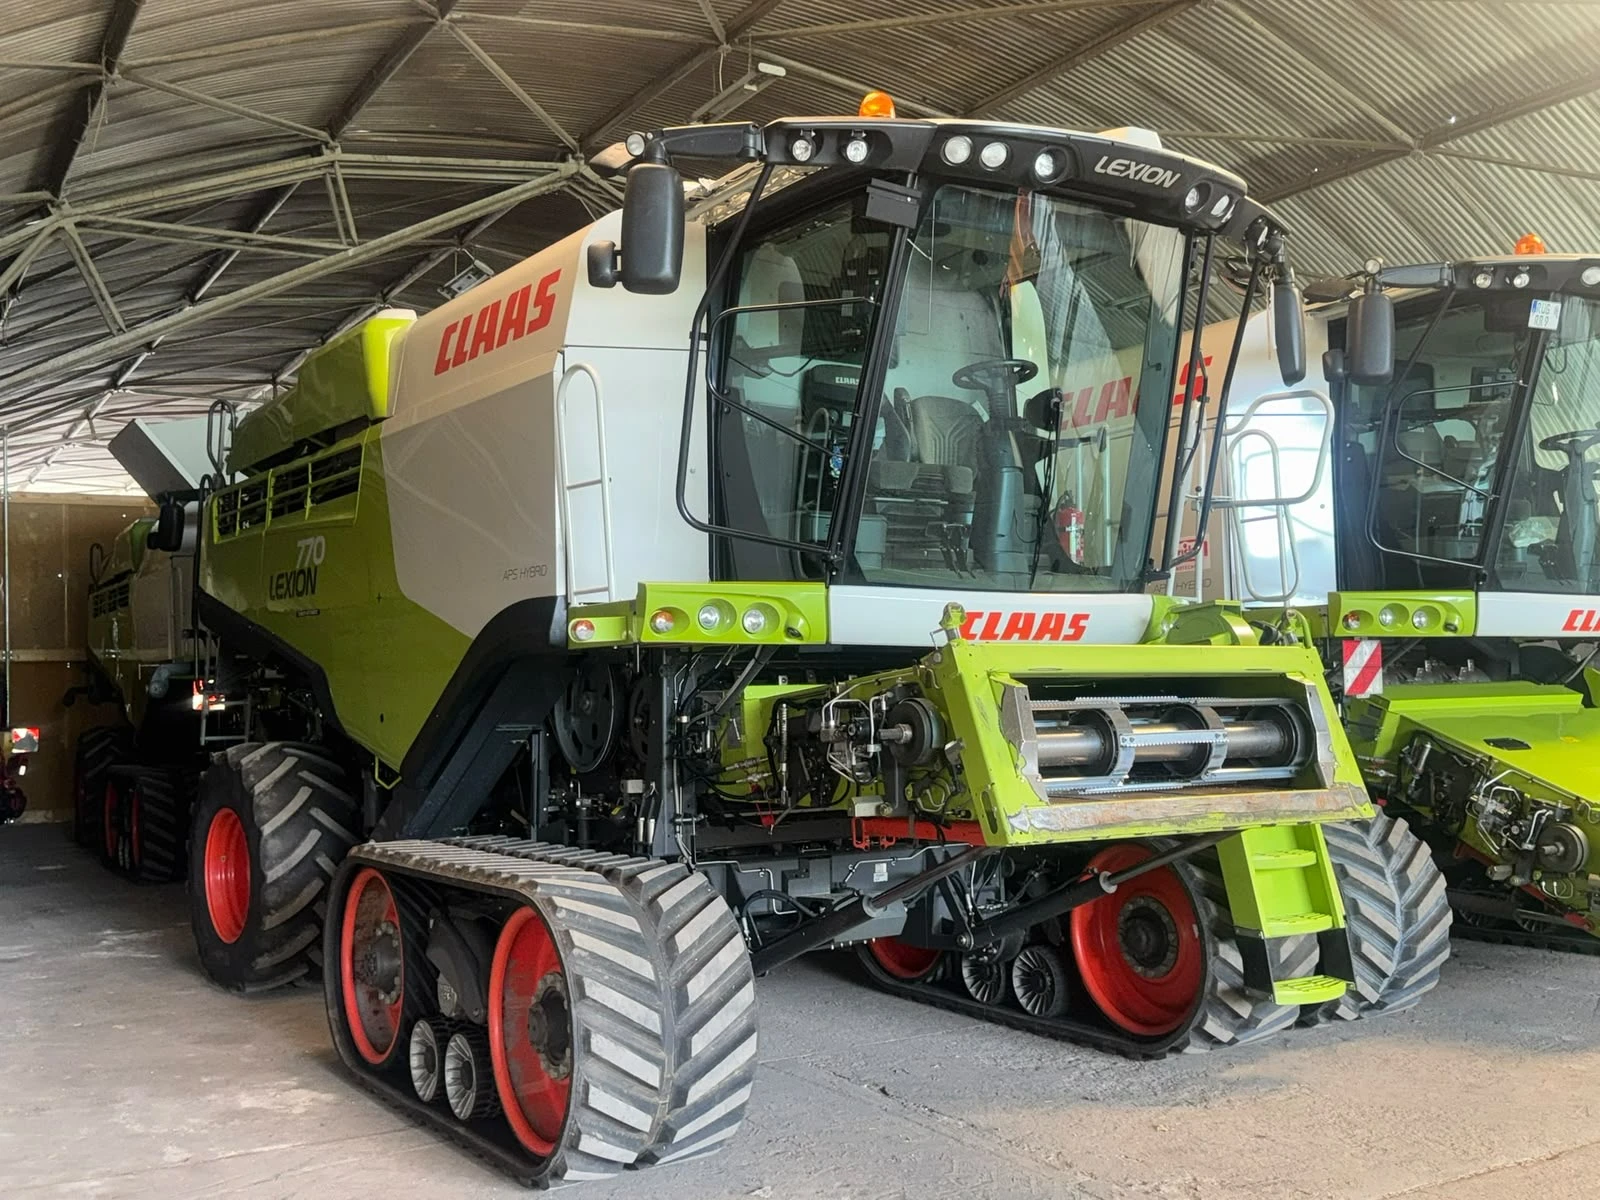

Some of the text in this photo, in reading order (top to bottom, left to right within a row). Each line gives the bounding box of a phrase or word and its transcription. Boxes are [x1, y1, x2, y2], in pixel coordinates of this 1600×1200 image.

[1094, 156, 1181, 188] LEXION
[434, 268, 562, 376] CLAAS
[296, 536, 325, 568] 770
[270, 566, 317, 600] LEXION
[503, 564, 548, 580] APS HYBRID
[959, 612, 1090, 641] CLAAS
[1562, 609, 1600, 631] CL
